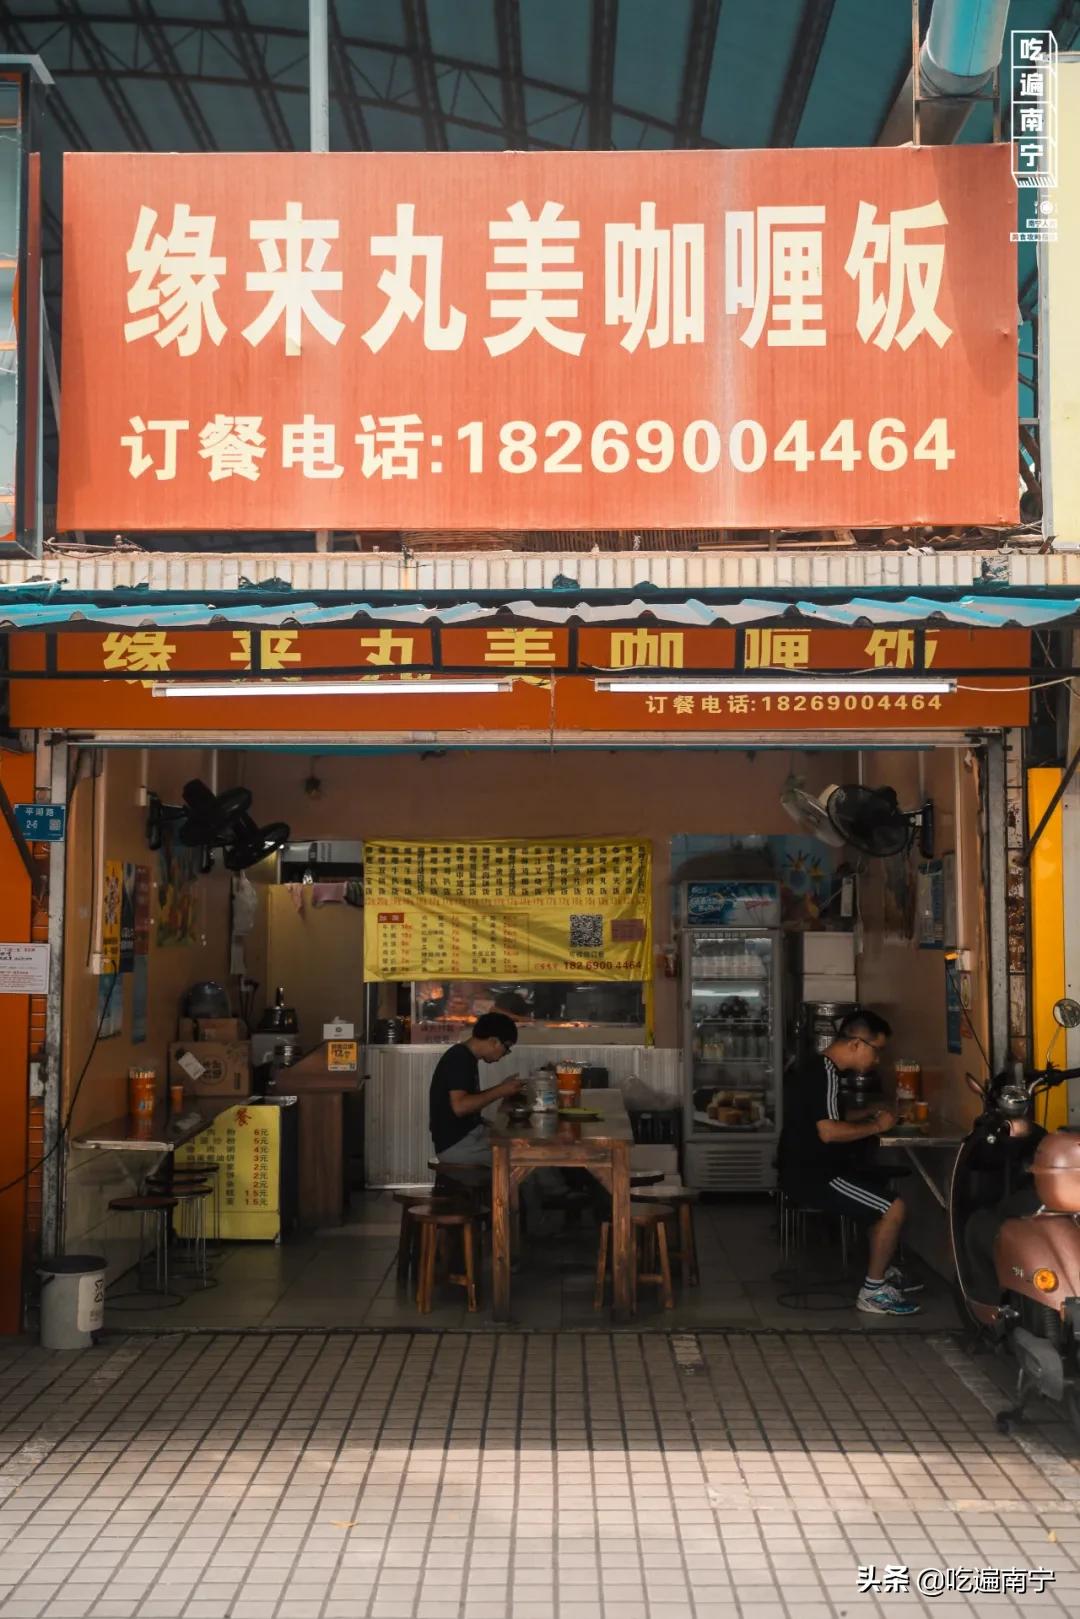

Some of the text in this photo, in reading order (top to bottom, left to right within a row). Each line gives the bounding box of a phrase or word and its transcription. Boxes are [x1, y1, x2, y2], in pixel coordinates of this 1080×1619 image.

[124, 201, 953, 359] 缘来丸美咖喱饭
[120, 414, 956, 482] 订餐电话:18269004464
[645, 694, 942, 714] 订餐电话:18269004464
